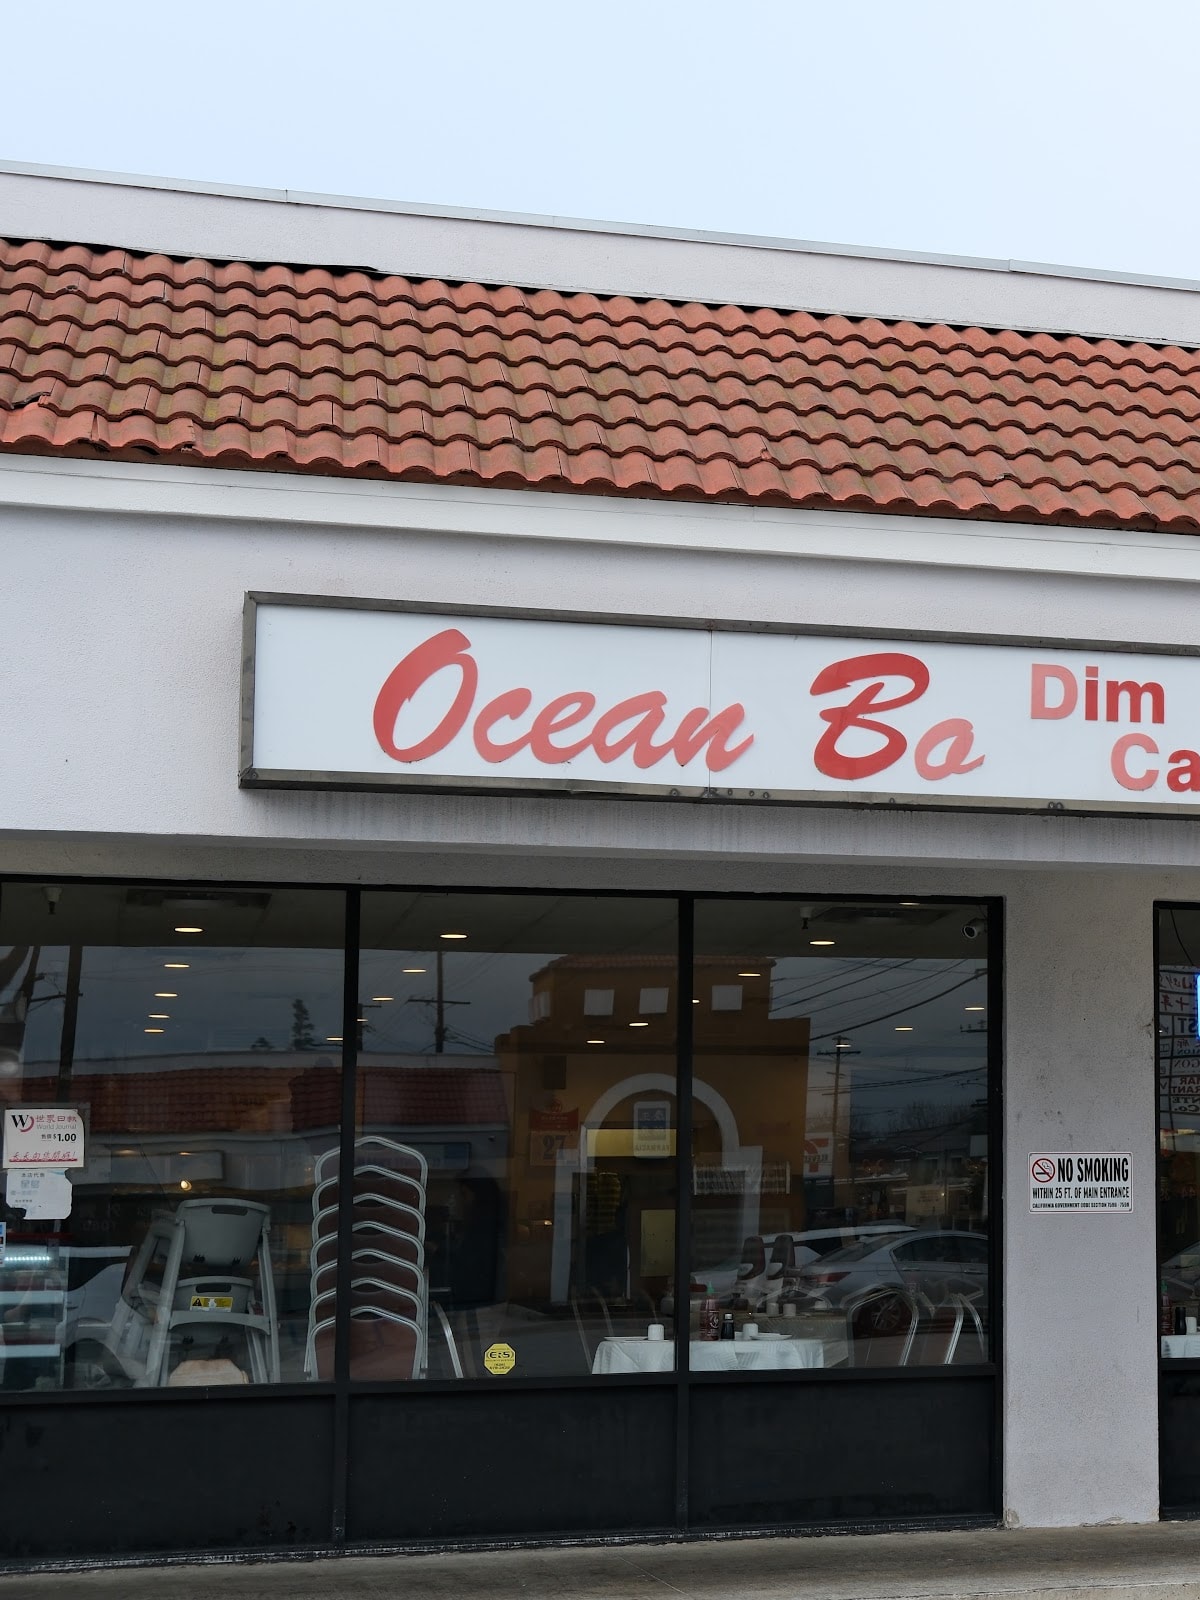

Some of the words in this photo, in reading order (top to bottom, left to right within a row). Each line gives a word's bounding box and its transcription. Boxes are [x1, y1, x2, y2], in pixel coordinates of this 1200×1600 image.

[372, 628, 754, 772] Ocean
[809, 652, 986, 781] Bo
[1030, 663, 1165, 724] Dim
[53, 1133, 77, 1142] $1.00
[1058, 1158, 1073, 1182] NO
[1077, 1157, 1129, 1182] SMOKING
[1032, 1187, 1054, 1199] WITHIN
[1055, 1187, 1063, 1199] 25
[1064, 1187, 1073, 1199] FT.
[1074, 1187, 1082, 1198] OF
[1083, 1187, 1098, 1198] MAIN
[1099, 1186, 1130, 1198] ENTRANCE
